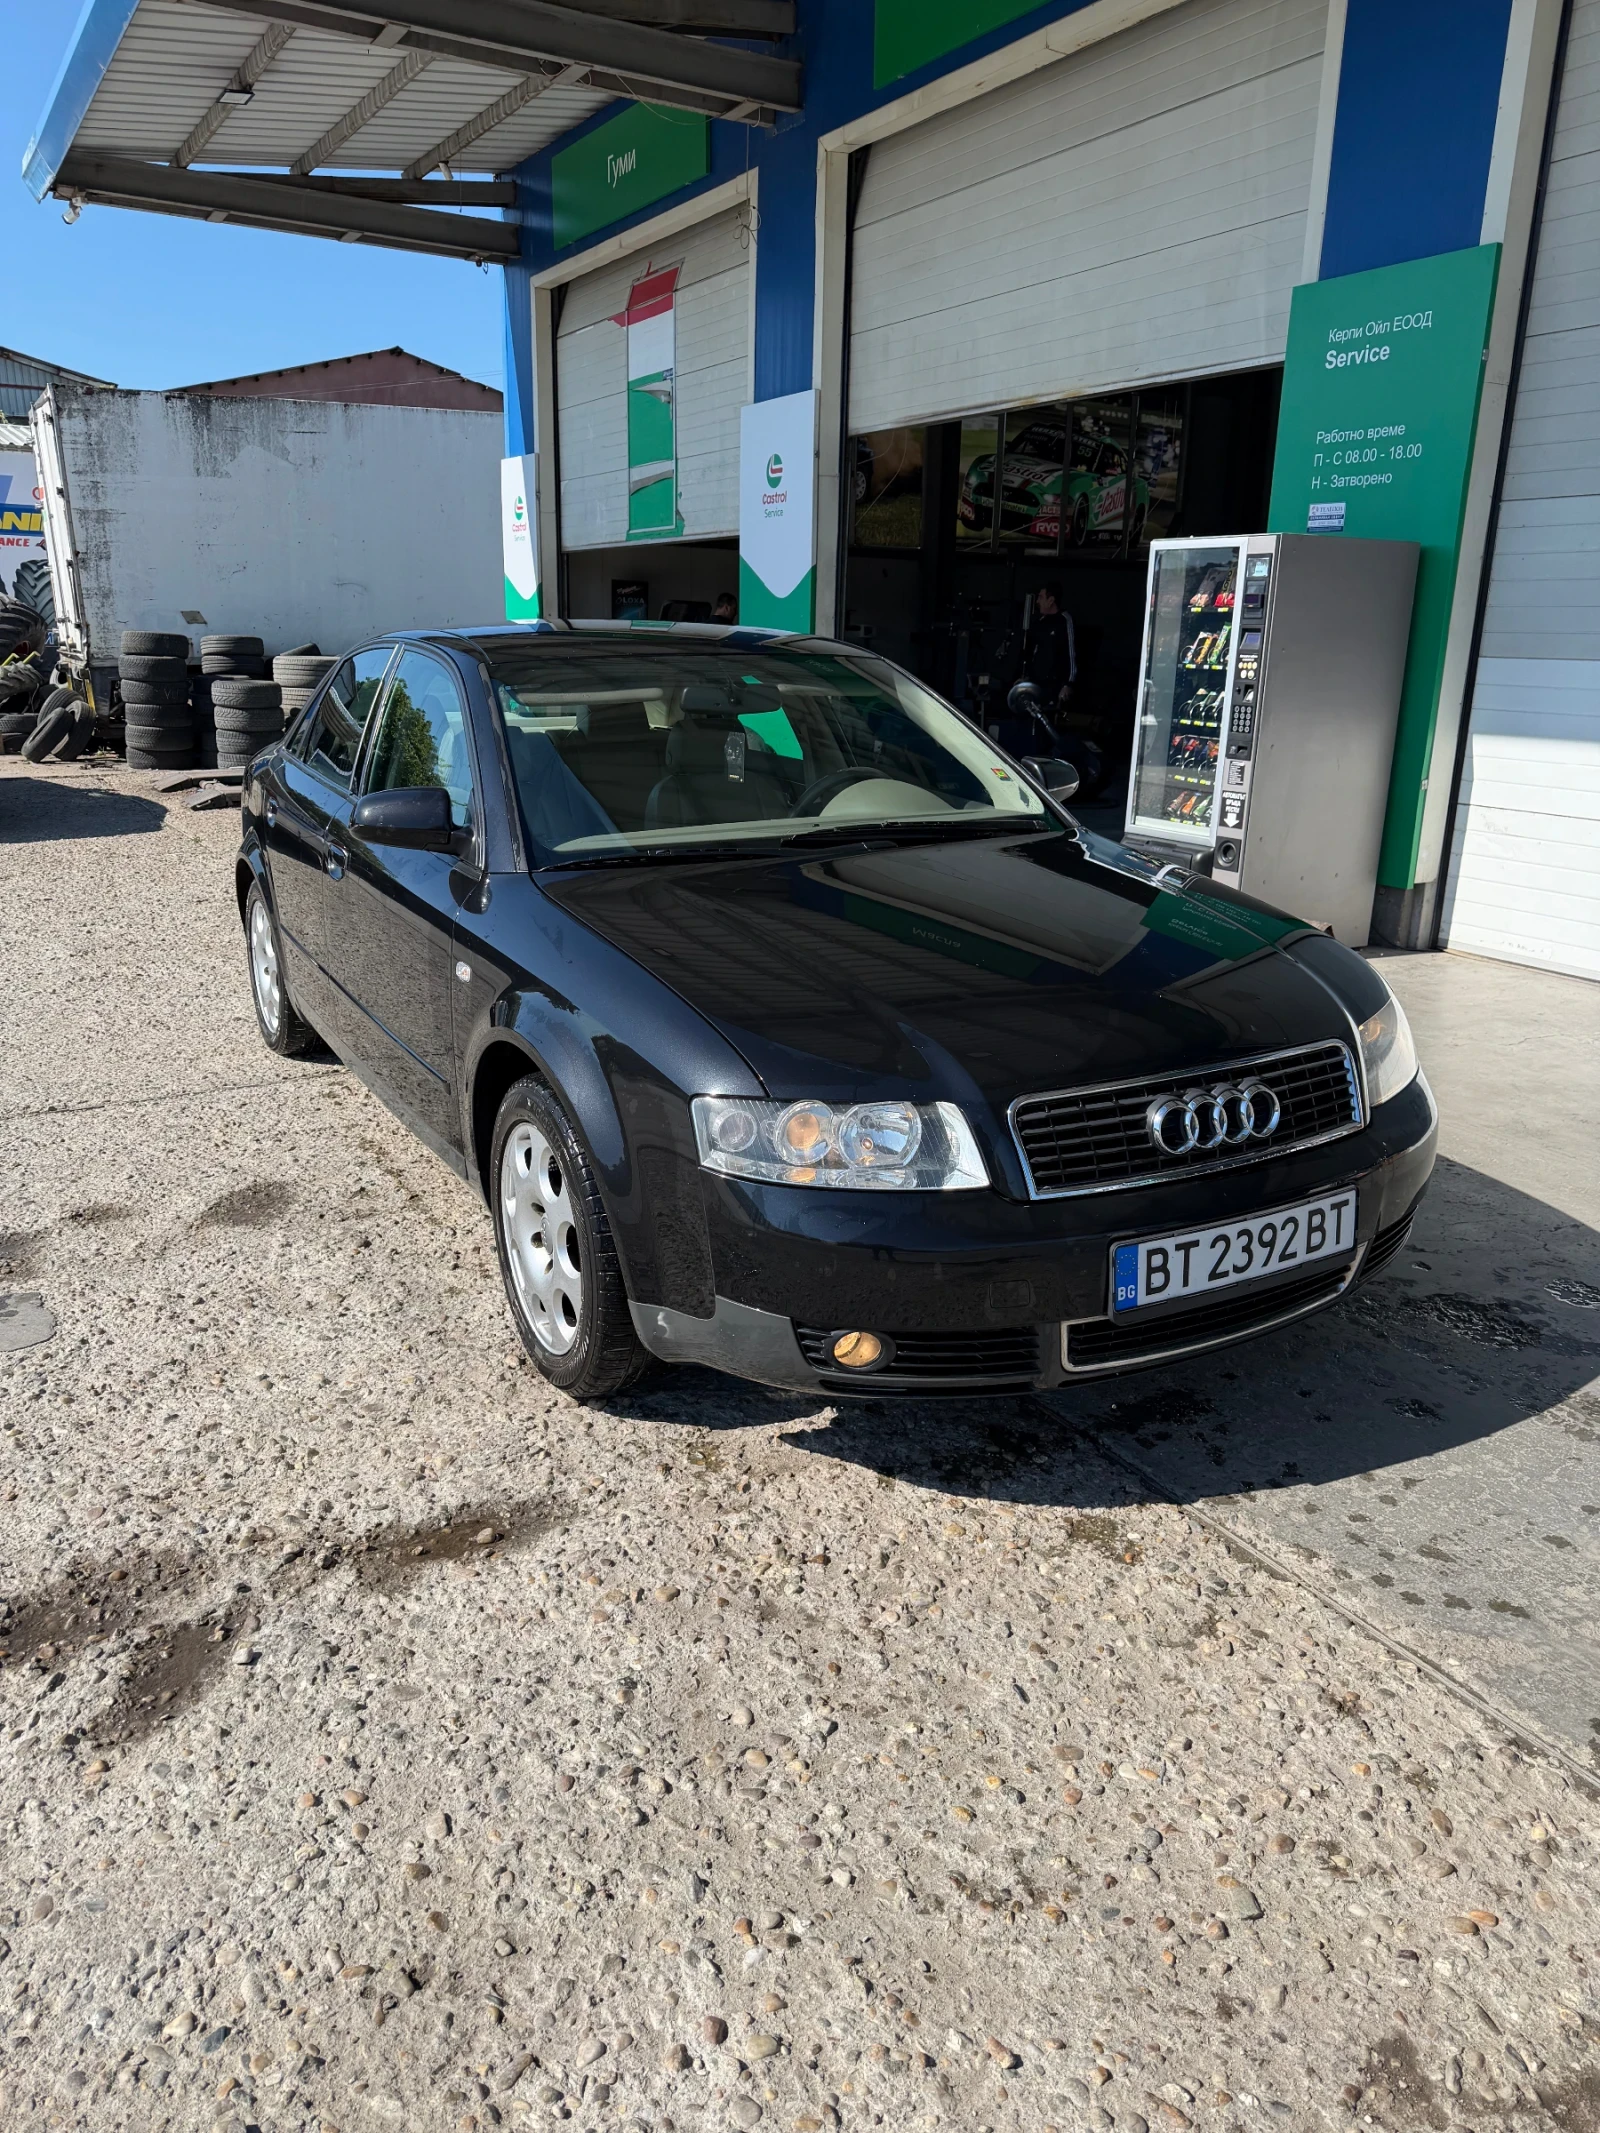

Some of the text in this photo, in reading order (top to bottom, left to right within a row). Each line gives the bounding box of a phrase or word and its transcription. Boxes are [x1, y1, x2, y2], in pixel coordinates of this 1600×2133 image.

[607, 148, 636, 189] Гуми
[1328, 310, 1433, 344] Керпи Ойл ЕООД
[1325, 344, 1390, 370] Service
[1316, 424, 1406, 445] Работно време
[1313, 453, 1323, 467] П
[1333, 451, 1342, 465] С
[1345, 447, 1378, 464] 08.00
[1389, 443, 1422, 460] 18.00
[1311, 476, 1321, 490] Н
[1330, 472, 1393, 488] Затворено
[762, 490, 788, 505] Castrol
[764, 507, 784, 518] Service
[512, 522, 527, 532] Castrol
[1117, 1285, 1136, 1301] BG
